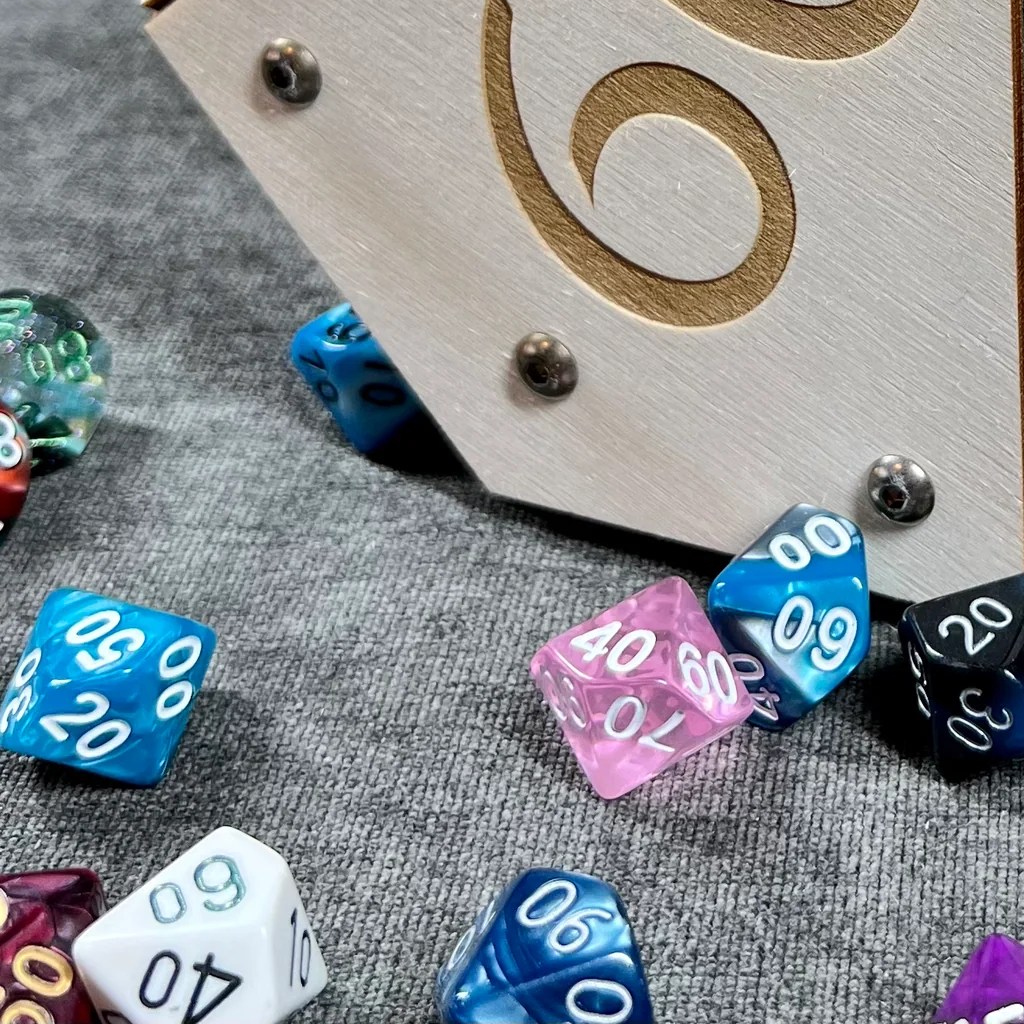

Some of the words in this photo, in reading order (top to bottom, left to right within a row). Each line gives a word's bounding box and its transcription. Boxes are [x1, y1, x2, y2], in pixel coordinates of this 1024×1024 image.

[769, 514, 852, 570] 00
[65, 609, 145, 672] 50
[570, 621, 657, 673] 40
[938, 596, 1014, 656] 20
[155, 634, 202, 721] 00
[678, 642, 738, 705] 60
[39, 691, 132, 760] 20
[946, 687, 1014, 752] 30
[290, 907, 311, 988] 10
[139, 950, 244, 1024] 40
